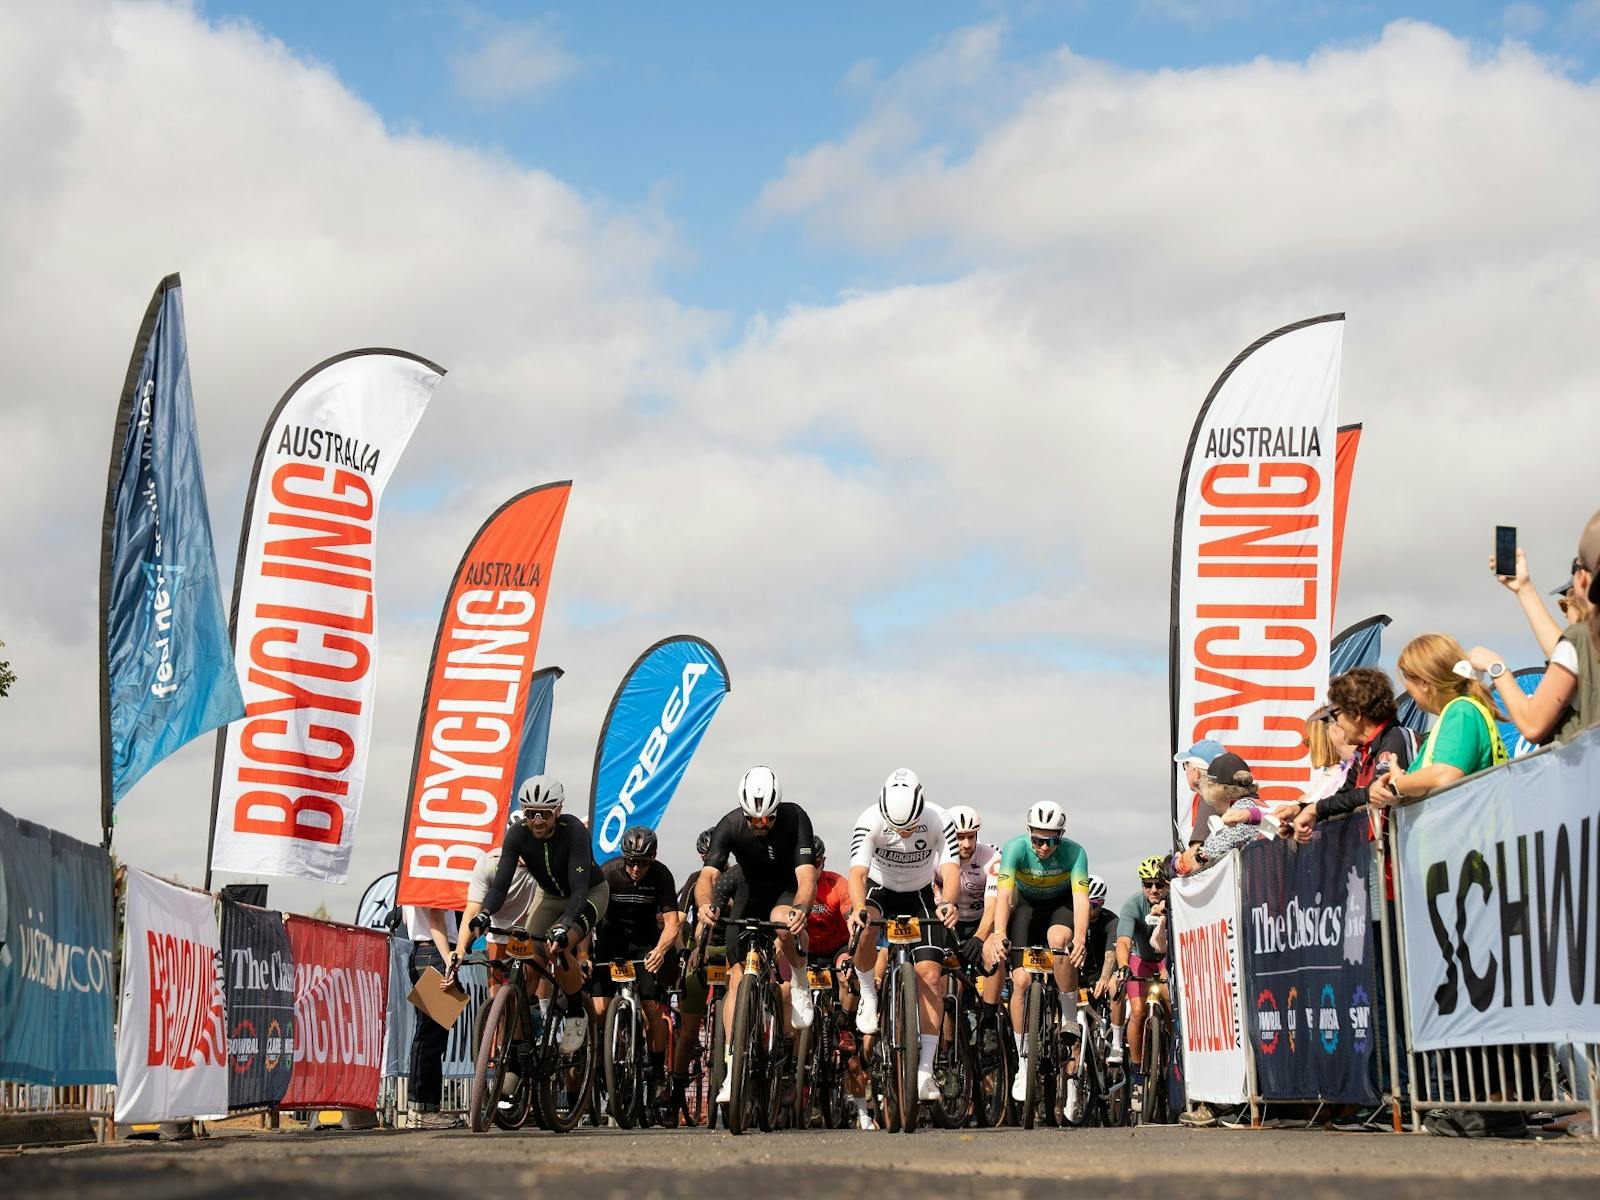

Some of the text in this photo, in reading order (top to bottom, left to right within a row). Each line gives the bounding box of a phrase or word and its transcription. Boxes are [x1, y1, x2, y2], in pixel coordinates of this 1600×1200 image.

[277, 425, 380, 476] AUSTRALIA
[1204, 426, 1321, 458] AUSTRALIA
[464, 562, 541, 587] AUSTRALIA
[234, 463, 375, 845] BICYCLING
[409, 589, 535, 883] BICYCLING
[599, 662, 709, 853] ORBEA
[1252, 903, 1286, 954] The
[1426, 812, 1600, 1015] SCHW
[231, 948, 270, 990] The
